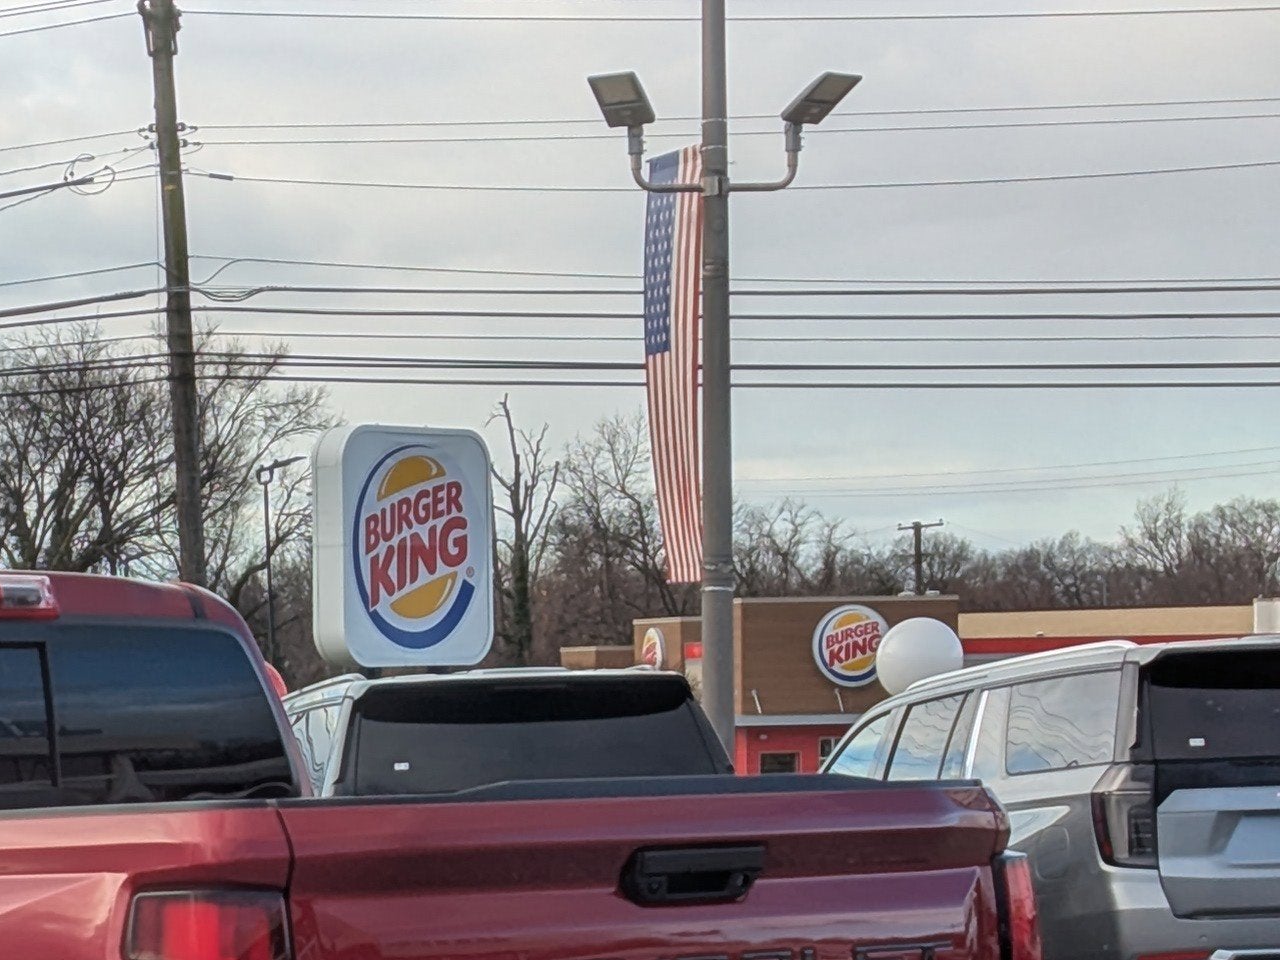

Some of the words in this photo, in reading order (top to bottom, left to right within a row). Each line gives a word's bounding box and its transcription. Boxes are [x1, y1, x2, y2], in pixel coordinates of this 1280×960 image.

[365, 480, 464, 555] BURGER
[369, 515, 468, 610] KING
[826, 621, 880, 649] BURGER
